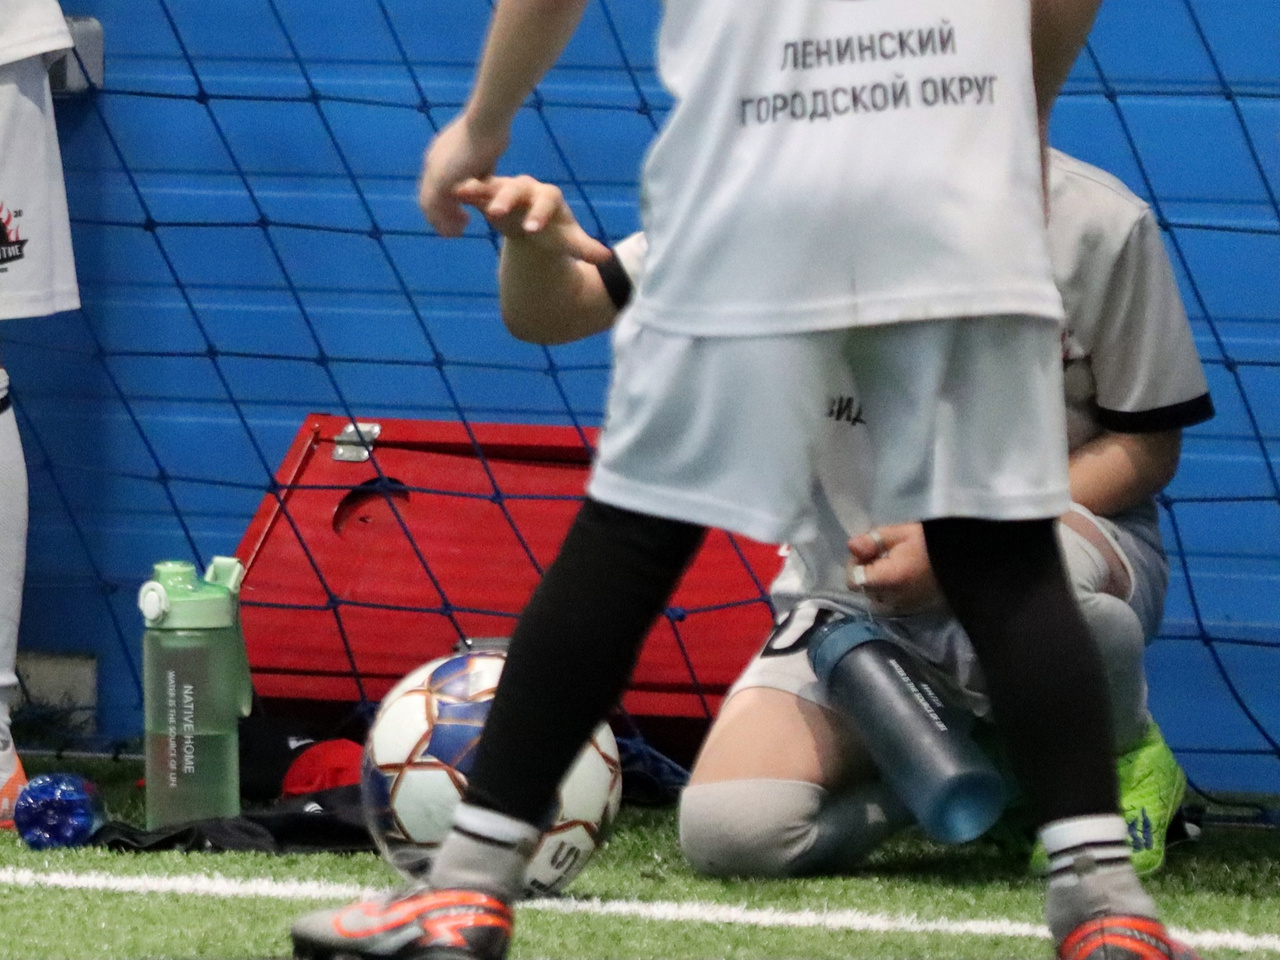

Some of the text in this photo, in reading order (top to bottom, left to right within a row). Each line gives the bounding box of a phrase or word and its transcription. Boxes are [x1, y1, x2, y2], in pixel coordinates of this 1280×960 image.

[781, 19, 957, 71] ЛЕНИНСКИЙ
[740, 74, 998, 127] ГОРОДСКОЙ ОКРУГ
[183, 683, 195, 774] NATIVE HOME
